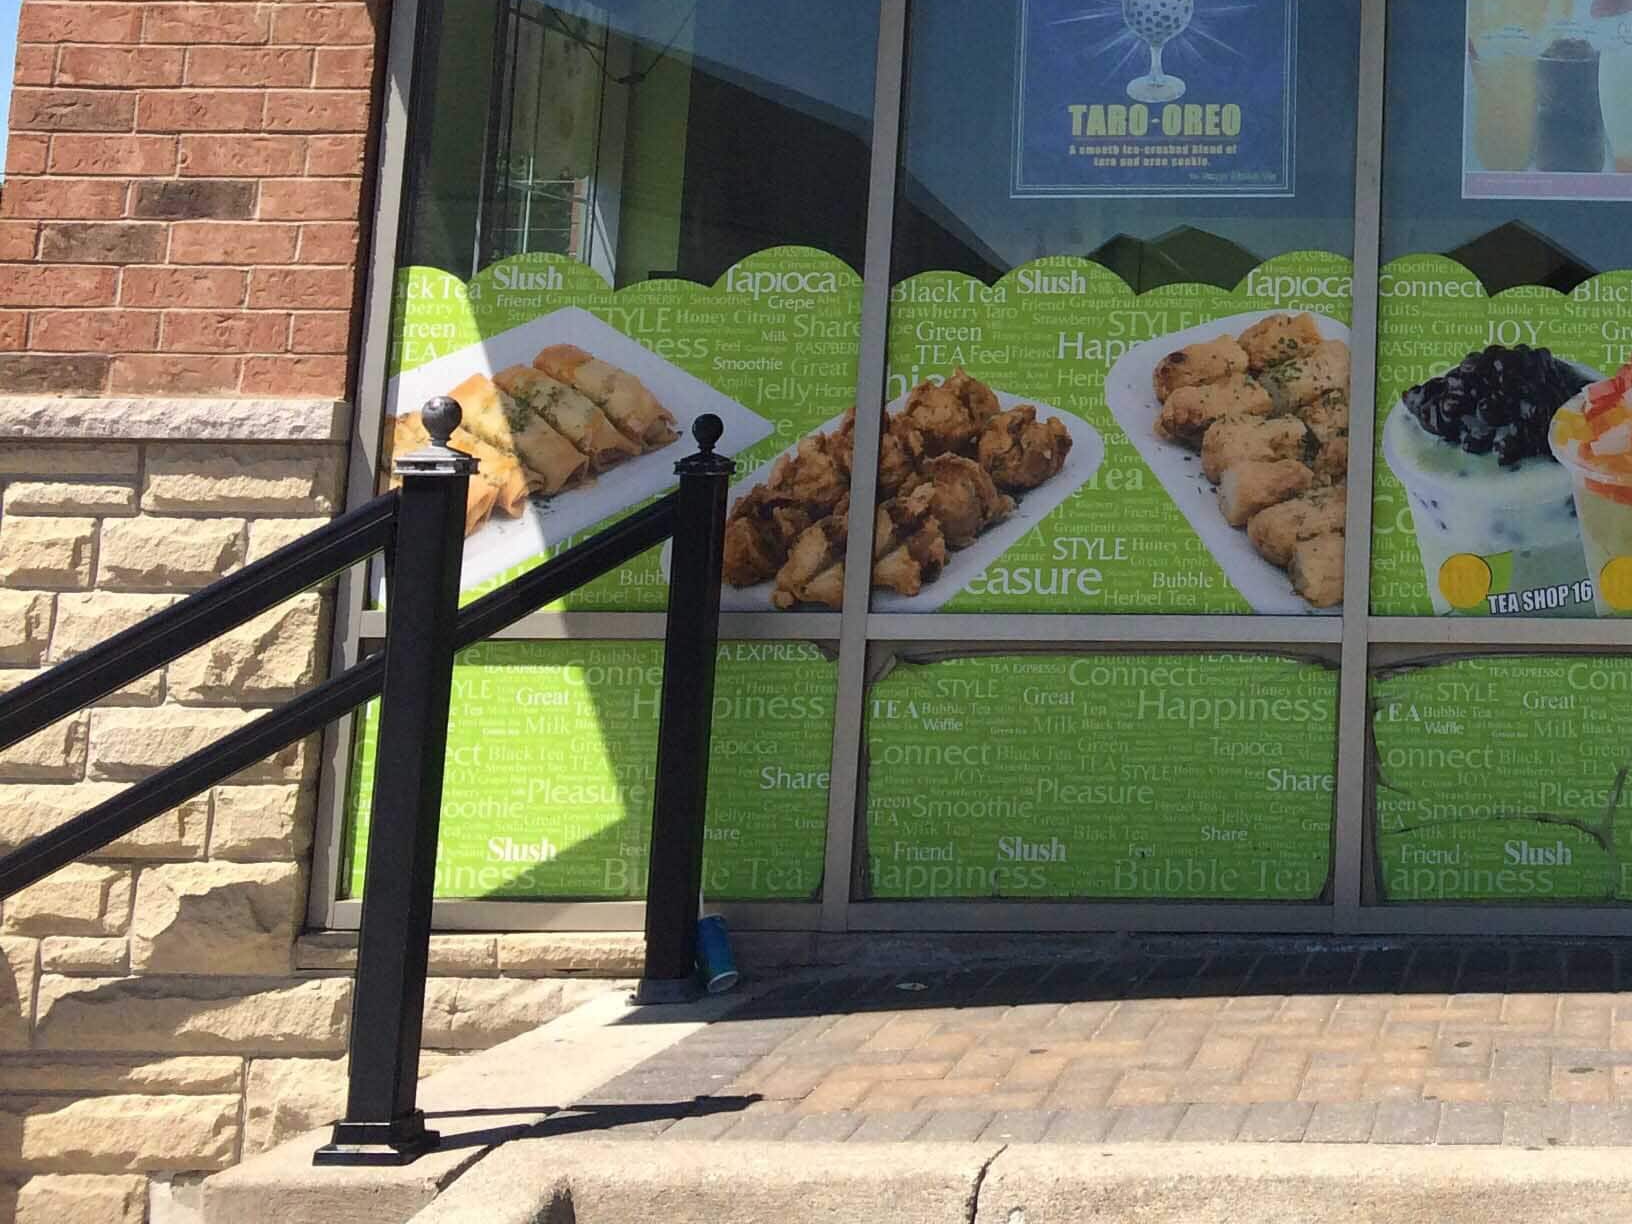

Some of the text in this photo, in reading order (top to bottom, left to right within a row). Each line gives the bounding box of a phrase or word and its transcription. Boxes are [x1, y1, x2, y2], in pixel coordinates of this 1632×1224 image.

[1068, 103, 1242, 137] TARO-OREO
[493, 265, 564, 292] Slush
[890, 278, 1009, 304] Black Tea
[1016, 268, 1087, 295] Slush
[1379, 274, 1486, 298] Connect
[767, 296, 817, 313] Crepe
[915, 320, 984, 342] Green
[1483, 318, 1546, 347] JOY
[712, 358, 784, 373] Smoothie
[914, 344, 1010, 367] TEA Feel
[1051, 537, 1128, 562] STYLE
[1152, 571, 1215, 589] Bubble
[1487, 579, 1593, 615] TEA SHOP 16
[1068, 659, 1203, 687] Connect
[515, 686, 569, 707] Great
[937, 679, 1001, 698] STYLE
[1022, 686, 1075, 707] Great
[1436, 682, 1501, 703] STYLE
[1521, 690, 1576, 711] Great
[1137, 688, 1329, 730] Happiness
[1422, 720, 1466, 735] Waffle
[1206, 736, 1284, 761] Tapioca
[760, 765, 831, 790] Share
[1265, 768, 1335, 793] Share
[527, 777, 646, 806] Pleasure
[1035, 776, 1154, 806] Pleasure
[912, 793, 1034, 819] Smoothie
[1418, 797, 1539, 822] Smoothie
[1199, 826, 1249, 842] Share
[488, 835, 559, 864] Slush
[893, 839, 955, 862] Friend
[997, 835, 1068, 864] Slush
[1399, 843, 1461, 866] Friend
[1503, 839, 1573, 867] Slush
[1111, 857, 1313, 894] Bubble Tea
